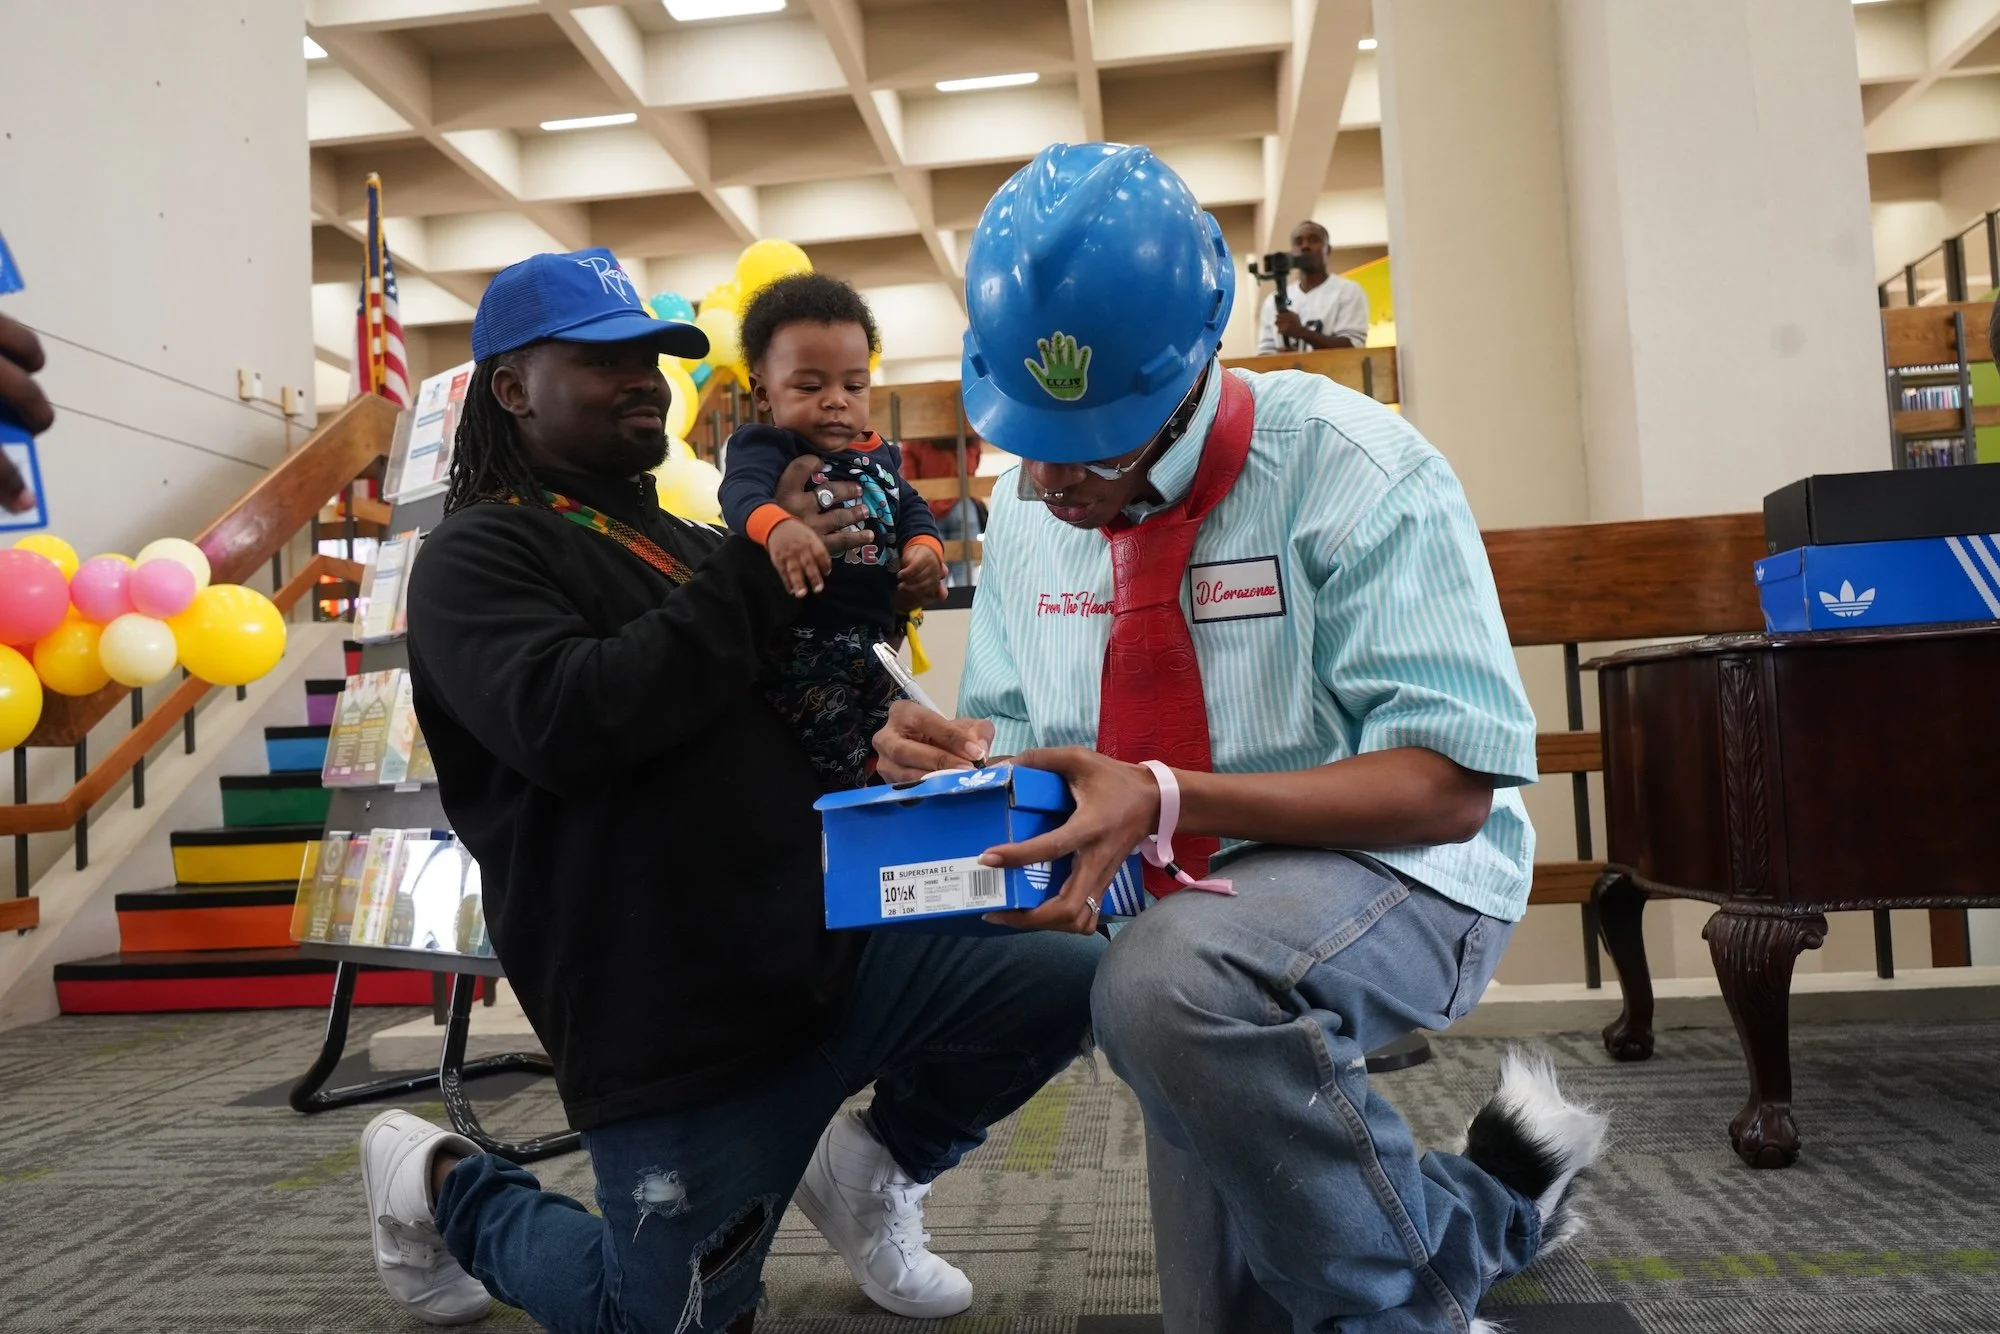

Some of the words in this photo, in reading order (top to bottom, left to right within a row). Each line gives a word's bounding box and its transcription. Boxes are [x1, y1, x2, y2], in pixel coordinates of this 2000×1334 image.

[1037, 593, 1061, 617] From
[1060, 592, 1079, 616] The
[899, 867, 939, 878] SUPERSTAR
[902, 907, 916, 915] 10K
